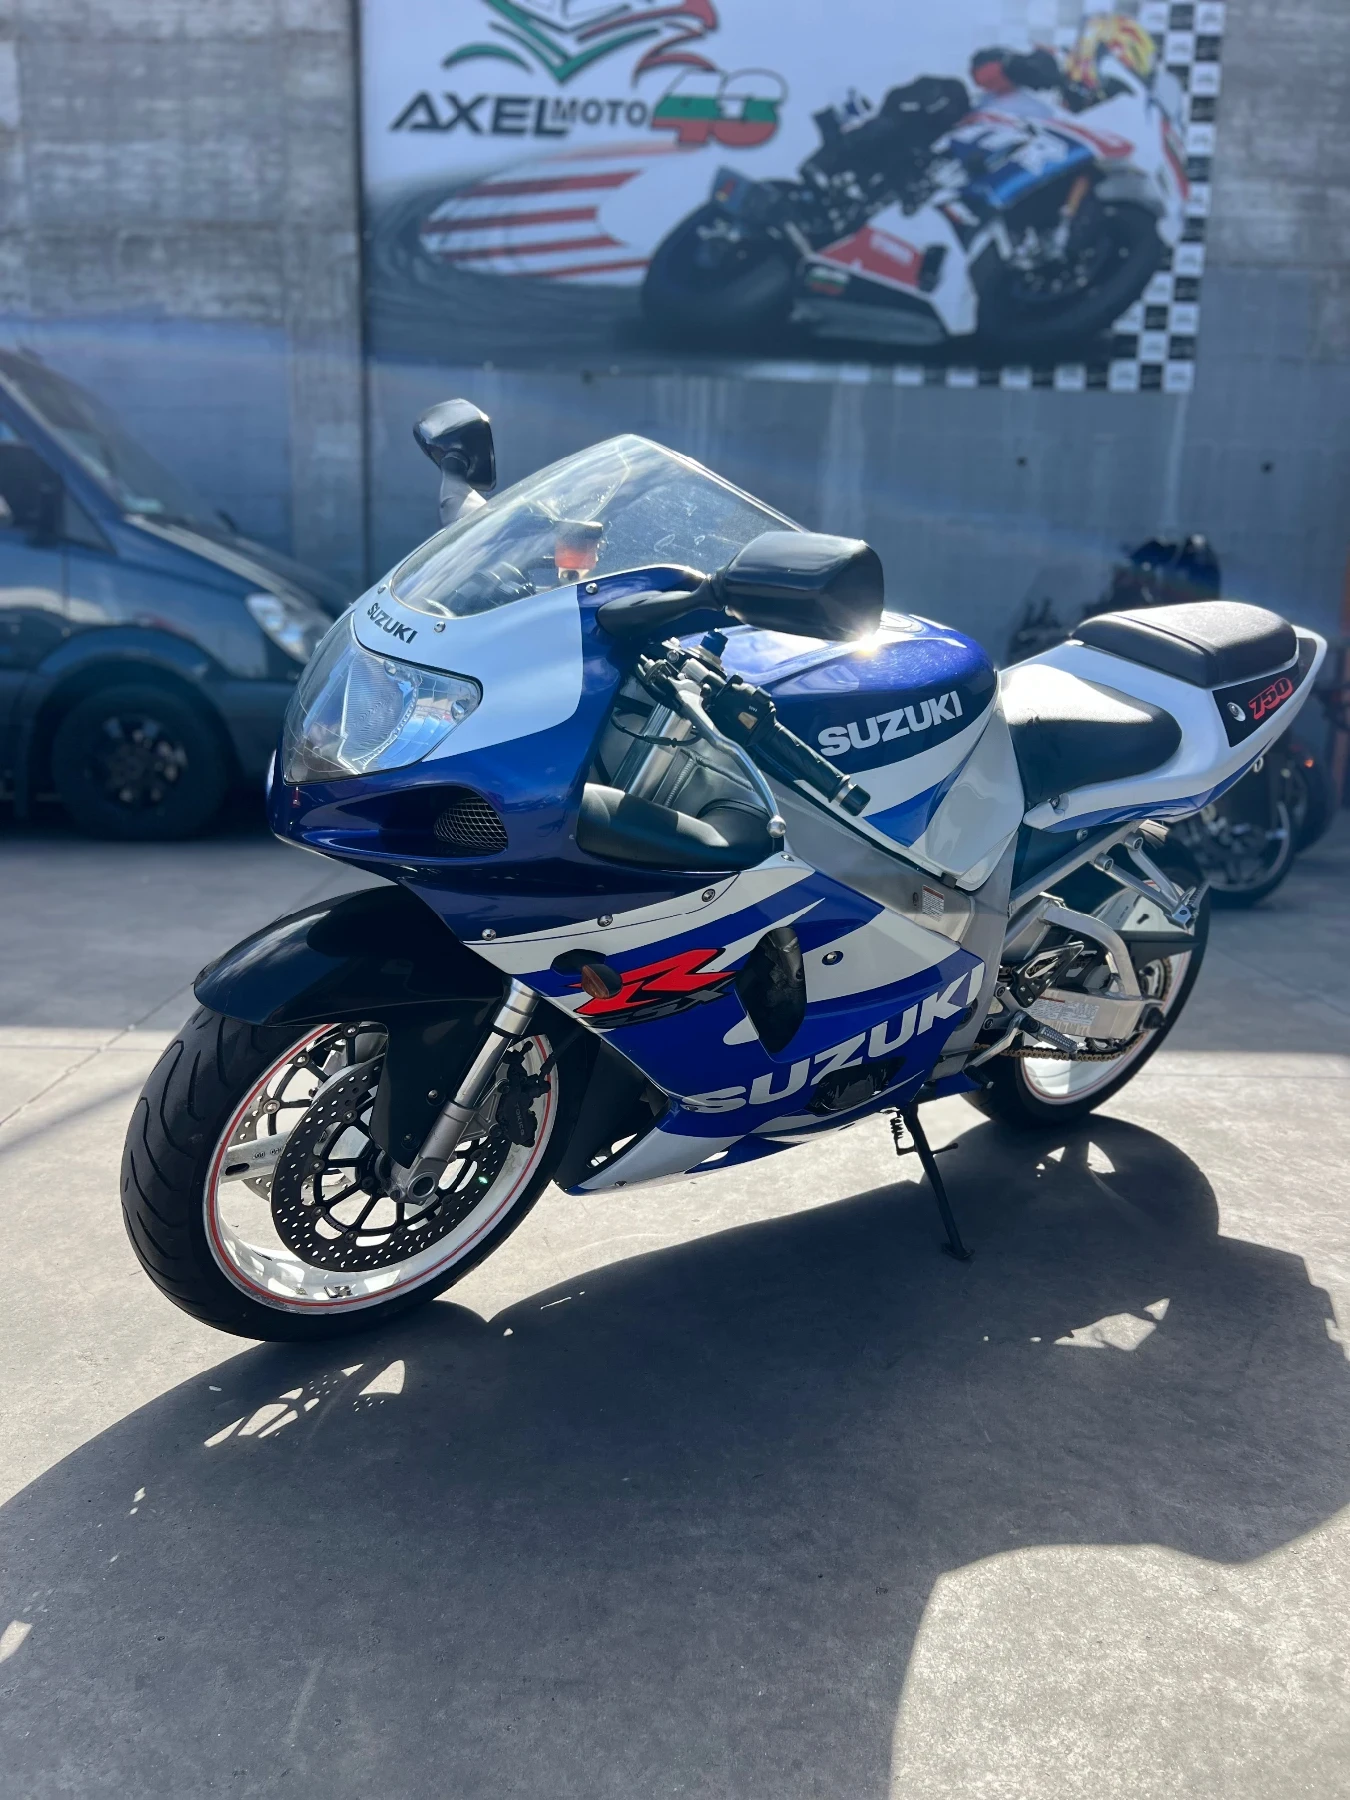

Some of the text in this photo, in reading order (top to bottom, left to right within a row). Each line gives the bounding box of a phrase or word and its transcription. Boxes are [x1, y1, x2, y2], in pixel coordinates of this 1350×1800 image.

[388, 90, 569, 138] AXEL
[549, 97, 648, 127] MOTO
[367, 602, 418, 644] SUZUKI
[1248, 677, 1293, 720] 750
[817, 690, 963, 757] SUZUKI
[680, 962, 985, 1114] SUZUKI
